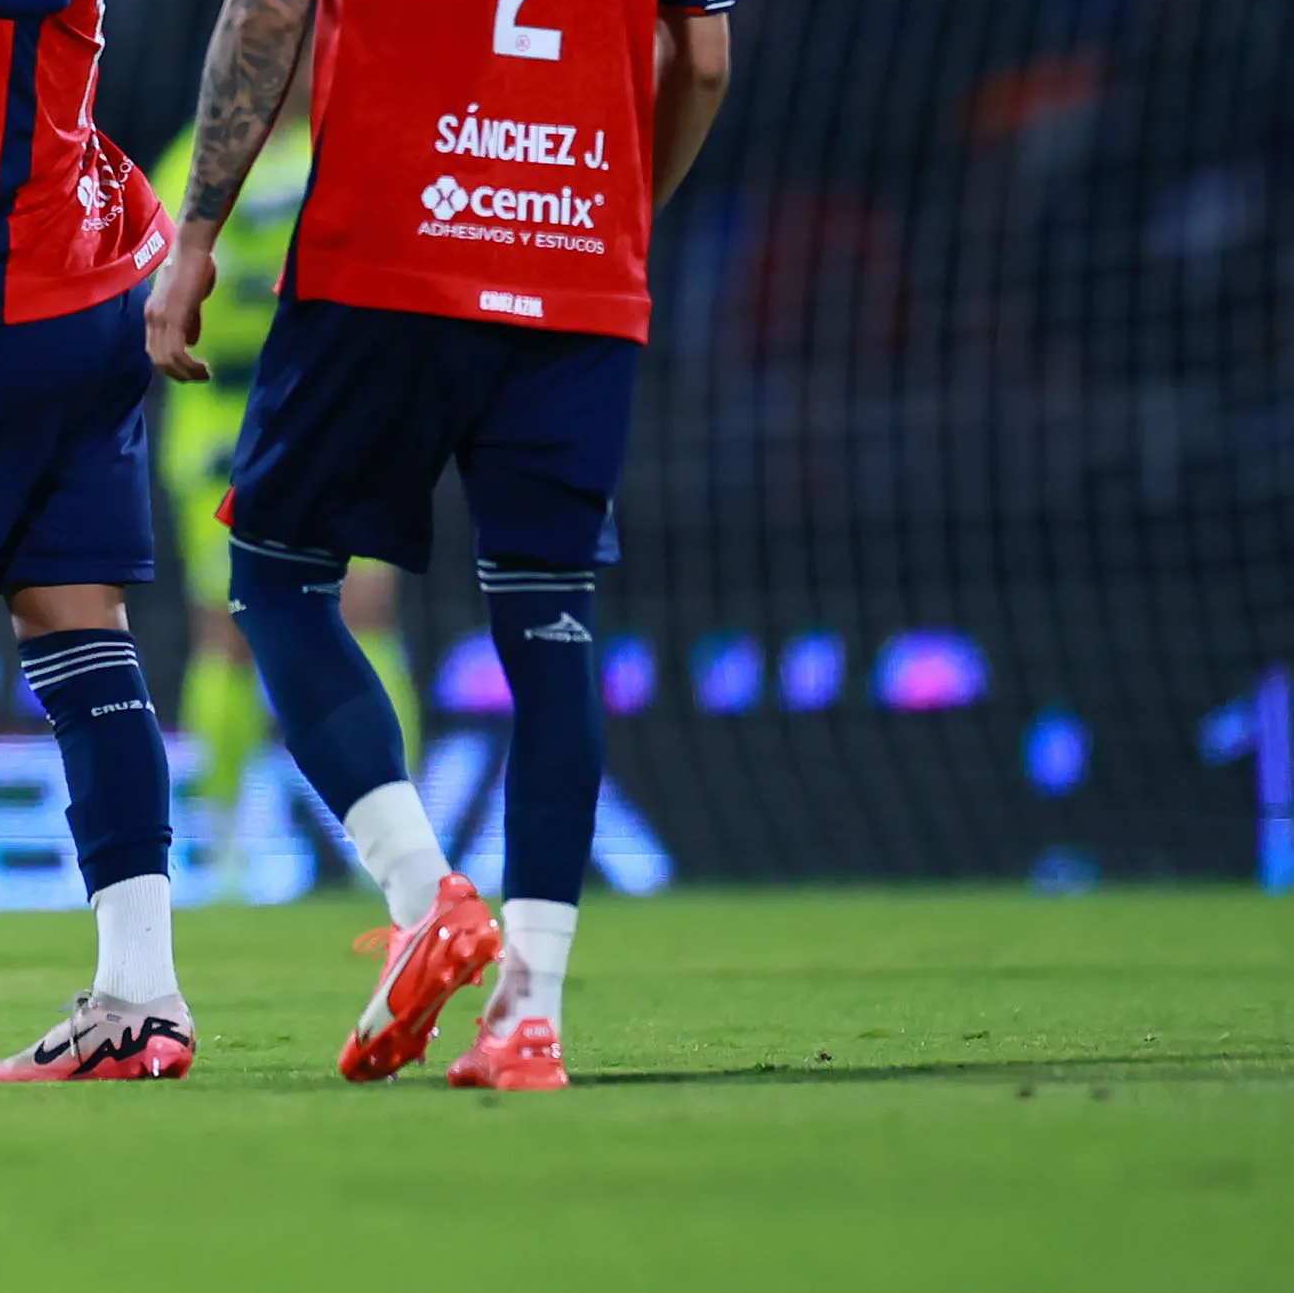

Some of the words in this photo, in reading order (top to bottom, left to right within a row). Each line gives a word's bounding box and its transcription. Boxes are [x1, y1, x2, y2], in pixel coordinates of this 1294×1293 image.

[434, 102, 577, 166] SÁNCHEZ
[584, 129, 610, 171] J.
[469, 185, 594, 229] cemix
[418, 220, 515, 245] ADHESIVOS
[519, 232, 532, 246] Y
[534, 233, 605, 255] ESTUCOS
[91, 699, 143, 717] CRUZ
